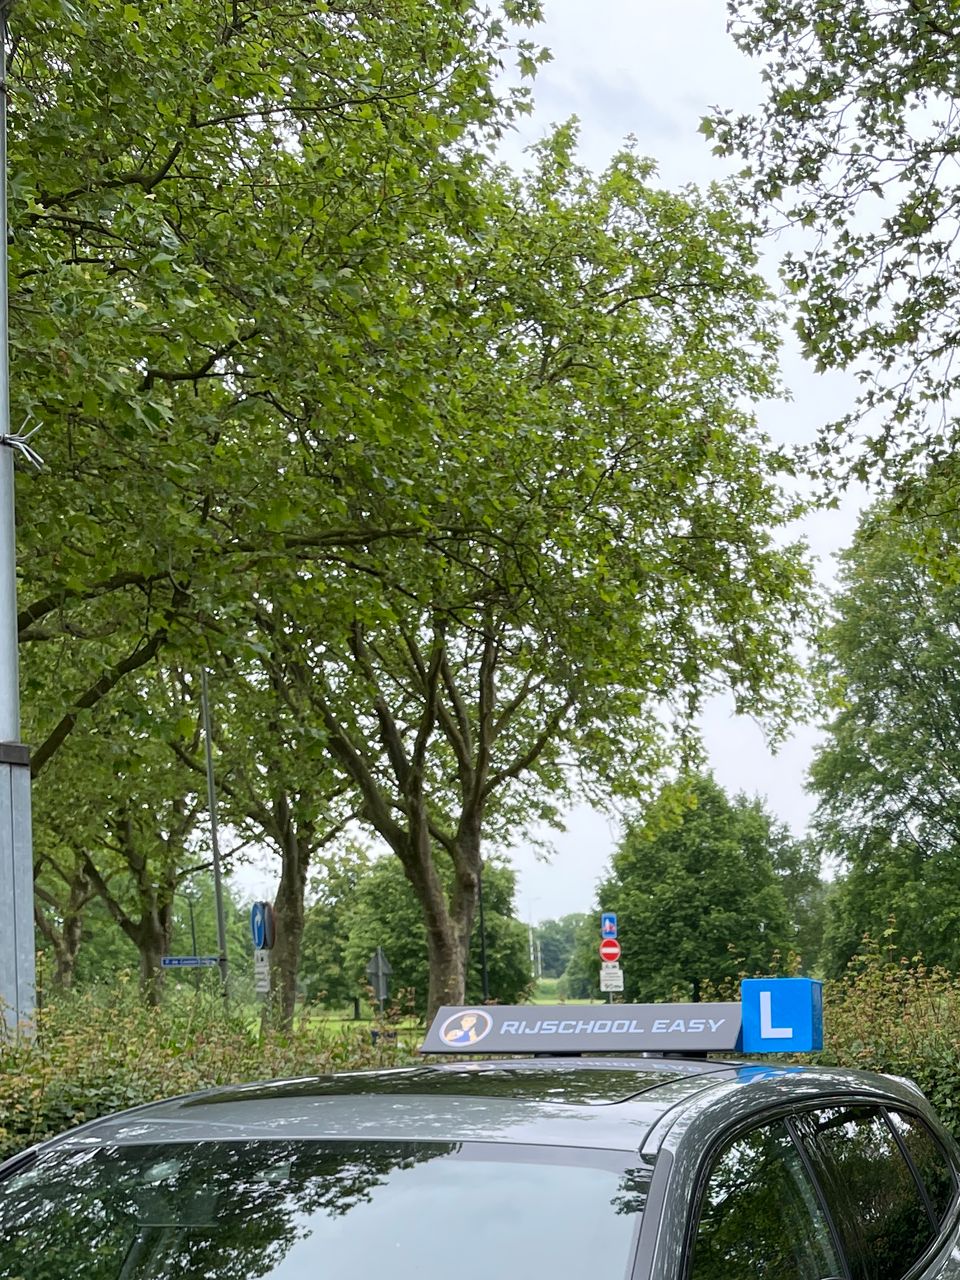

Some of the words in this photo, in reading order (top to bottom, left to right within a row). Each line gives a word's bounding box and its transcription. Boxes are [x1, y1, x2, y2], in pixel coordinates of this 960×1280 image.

[500, 1020, 645, 1035] RIJSCHOOL
[651, 1018, 726, 1034] EASY
[759, 991, 794, 1039] L
